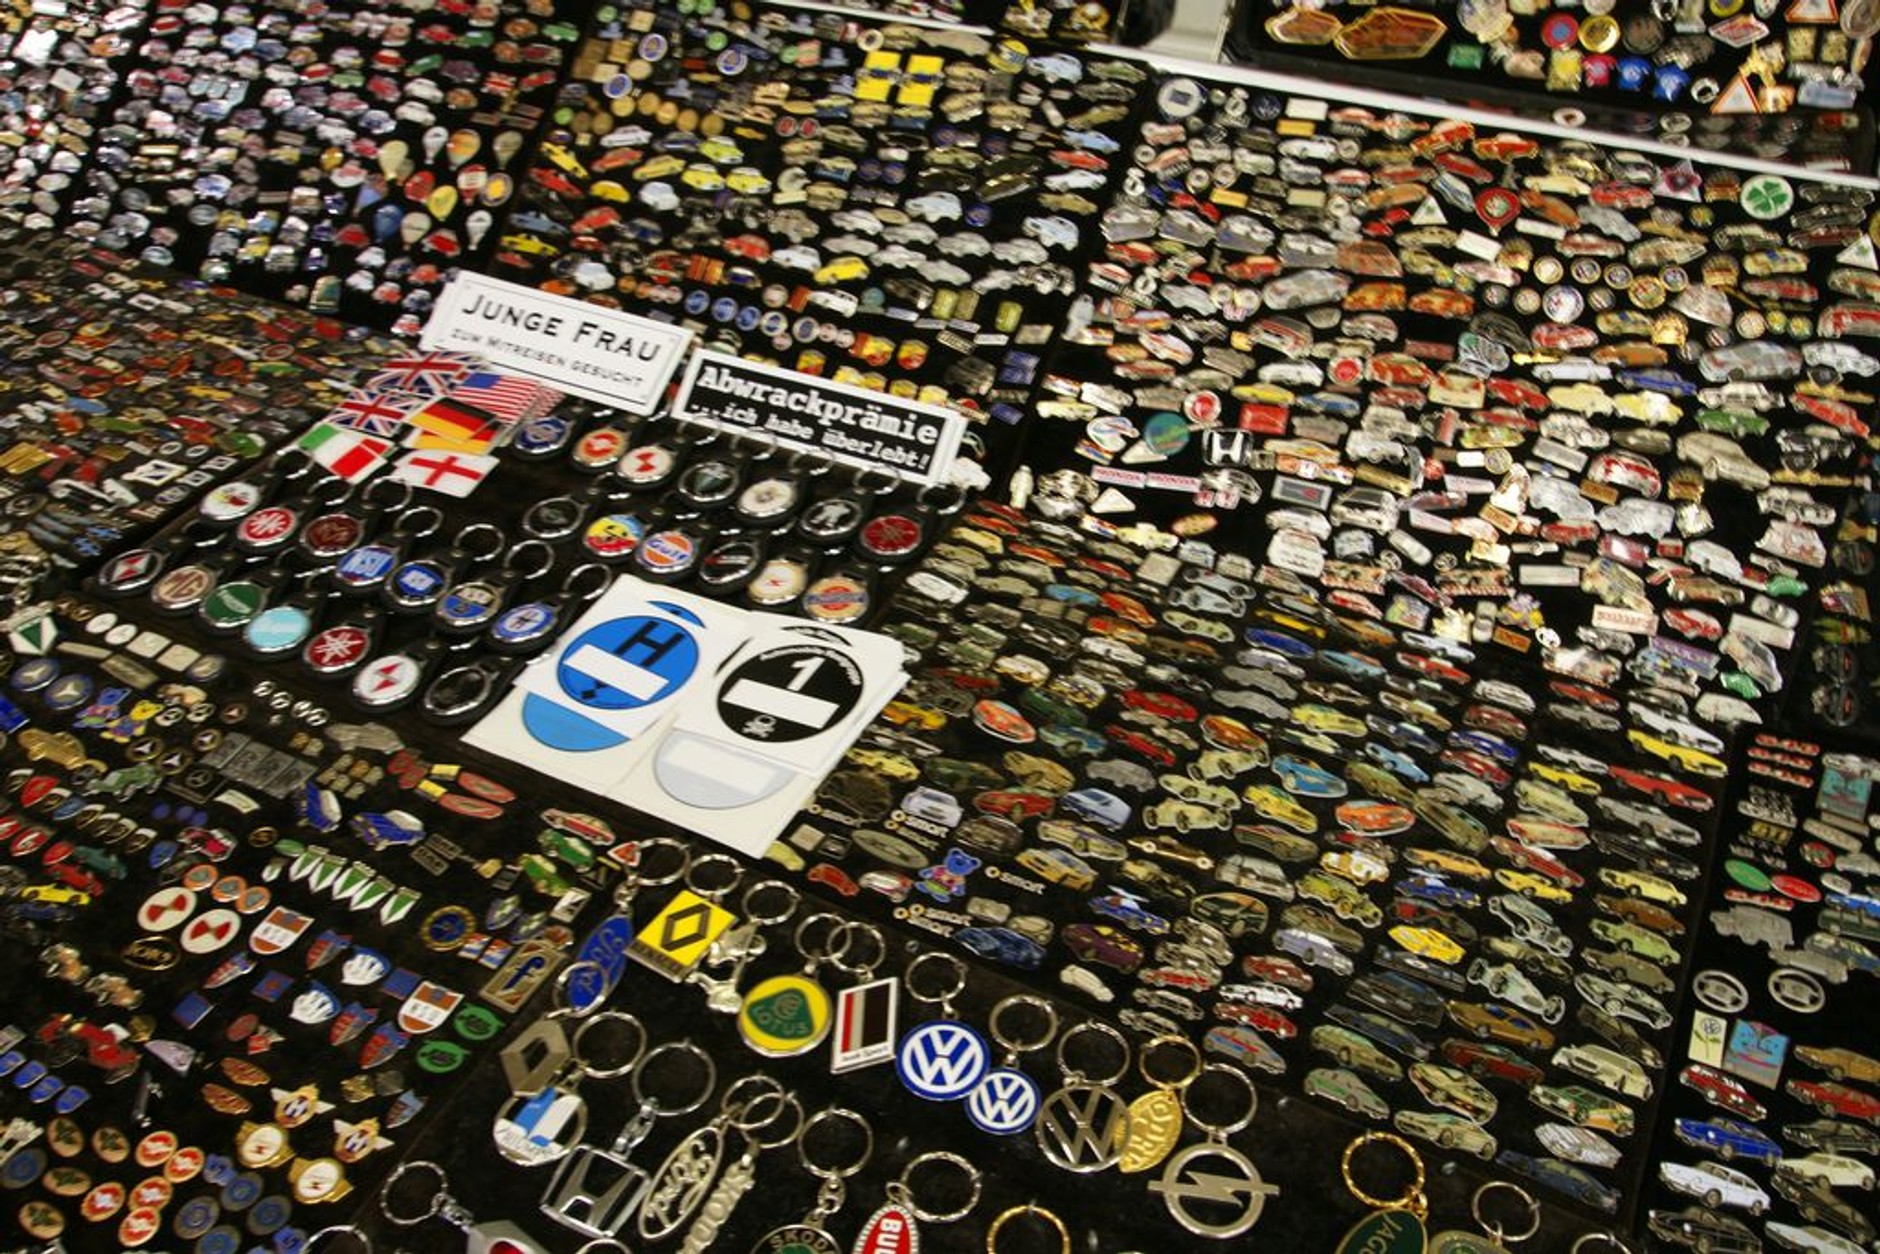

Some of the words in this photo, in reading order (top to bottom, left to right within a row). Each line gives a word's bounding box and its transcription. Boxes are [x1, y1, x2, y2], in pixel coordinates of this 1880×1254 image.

[462, 294, 564, 338] JUNGE
[573, 320, 661, 362] FRAU
[569, 359, 644, 388] GESUCHT
[696, 364, 938, 446] Abwrackprämie
[765, 412, 815, 440] habe
[821, 428, 928, 465] überlebt!
[613, 620, 686, 669] H
[791, 655, 825, 692] 1
[751, 1004, 809, 1036] LOTUS
